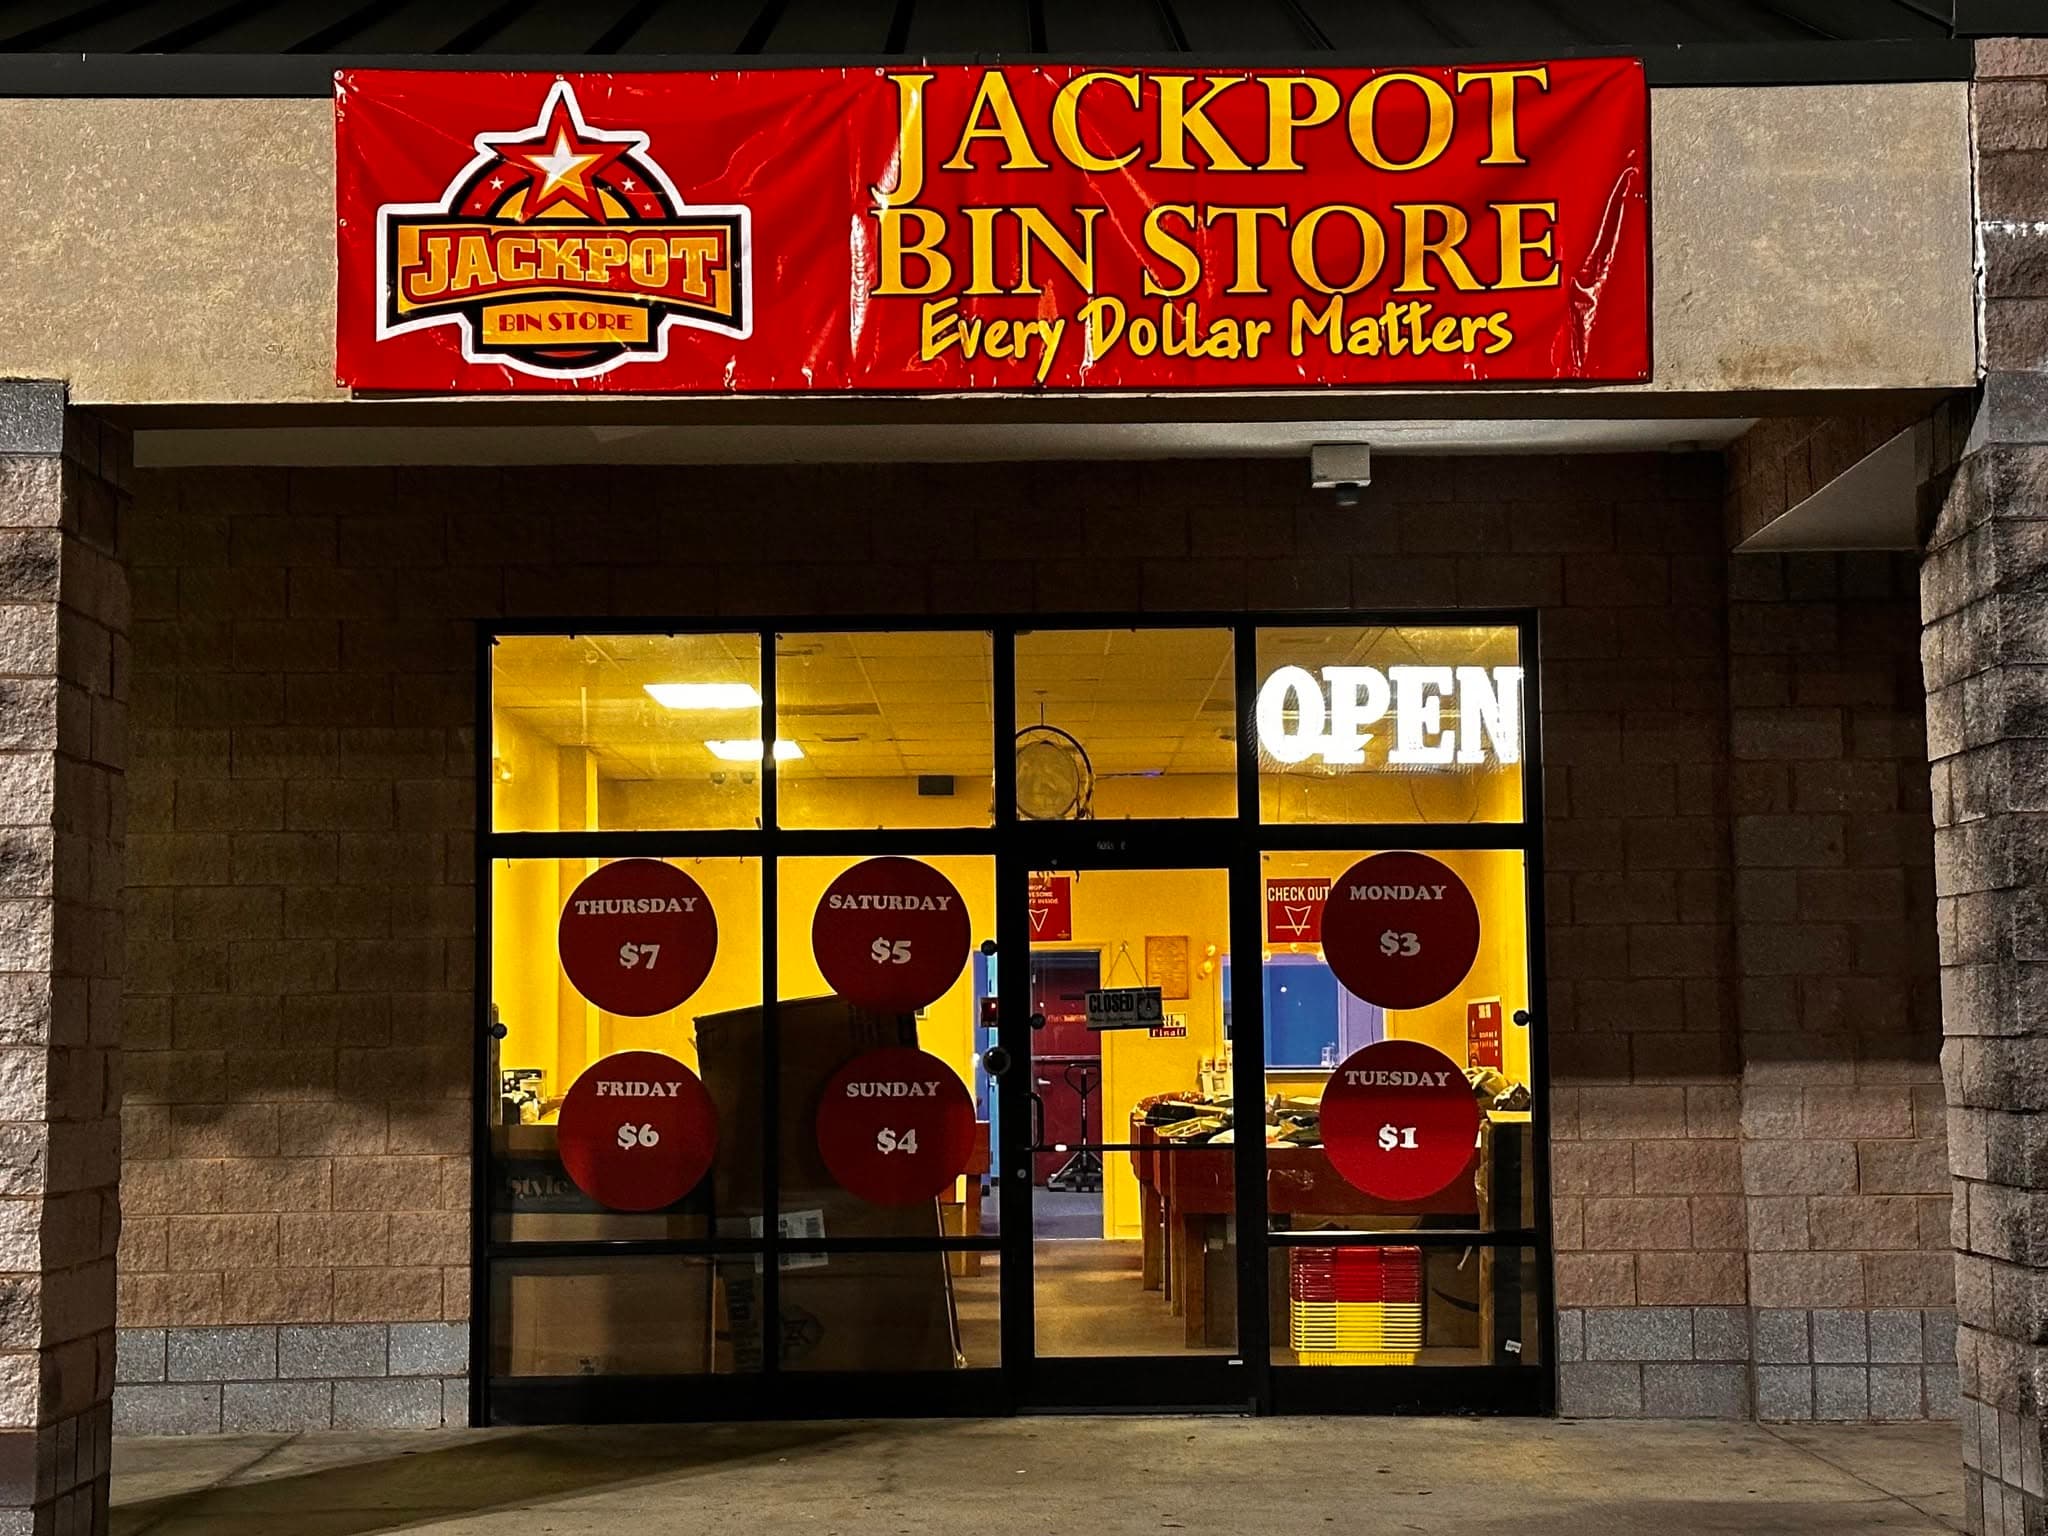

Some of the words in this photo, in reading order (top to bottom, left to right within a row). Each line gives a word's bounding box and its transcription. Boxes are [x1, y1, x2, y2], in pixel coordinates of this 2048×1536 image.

[869, 67, 1549, 206] JACKPOT
[870, 207, 1104, 297] BIN
[1141, 202, 1562, 296] STORE
[410, 236, 719, 297] JACKPOT
[499, 314, 541, 333] BIN
[548, 312, 633, 332] STORE
[920, 298, 1065, 382] Every
[1079, 296, 1271, 359] Dollar
[1289, 296, 1514, 356] Matters
[1255, 665, 1524, 764] OPEN
[575, 898, 698, 915] THURSDAY
[828, 894, 953, 912] SATURDAY
[1267, 886, 1306, 902] CHECK
[1307, 886, 1330, 902] OUT
[1350, 885, 1447, 901] MONDAY
[619, 942, 661, 969] $7
[871, 937, 912, 964] $5
[1379, 930, 1422, 957] $3
[1089, 993, 1134, 1013] CLOSED
[596, 1081, 683, 1098] FRIDAY
[846, 1081, 941, 1098] SUNDAY
[1344, 1070, 1451, 1088] TUESDAY
[617, 1122, 660, 1150] $6
[876, 1127, 919, 1155] $4
[1377, 1123, 1418, 1151] $1
